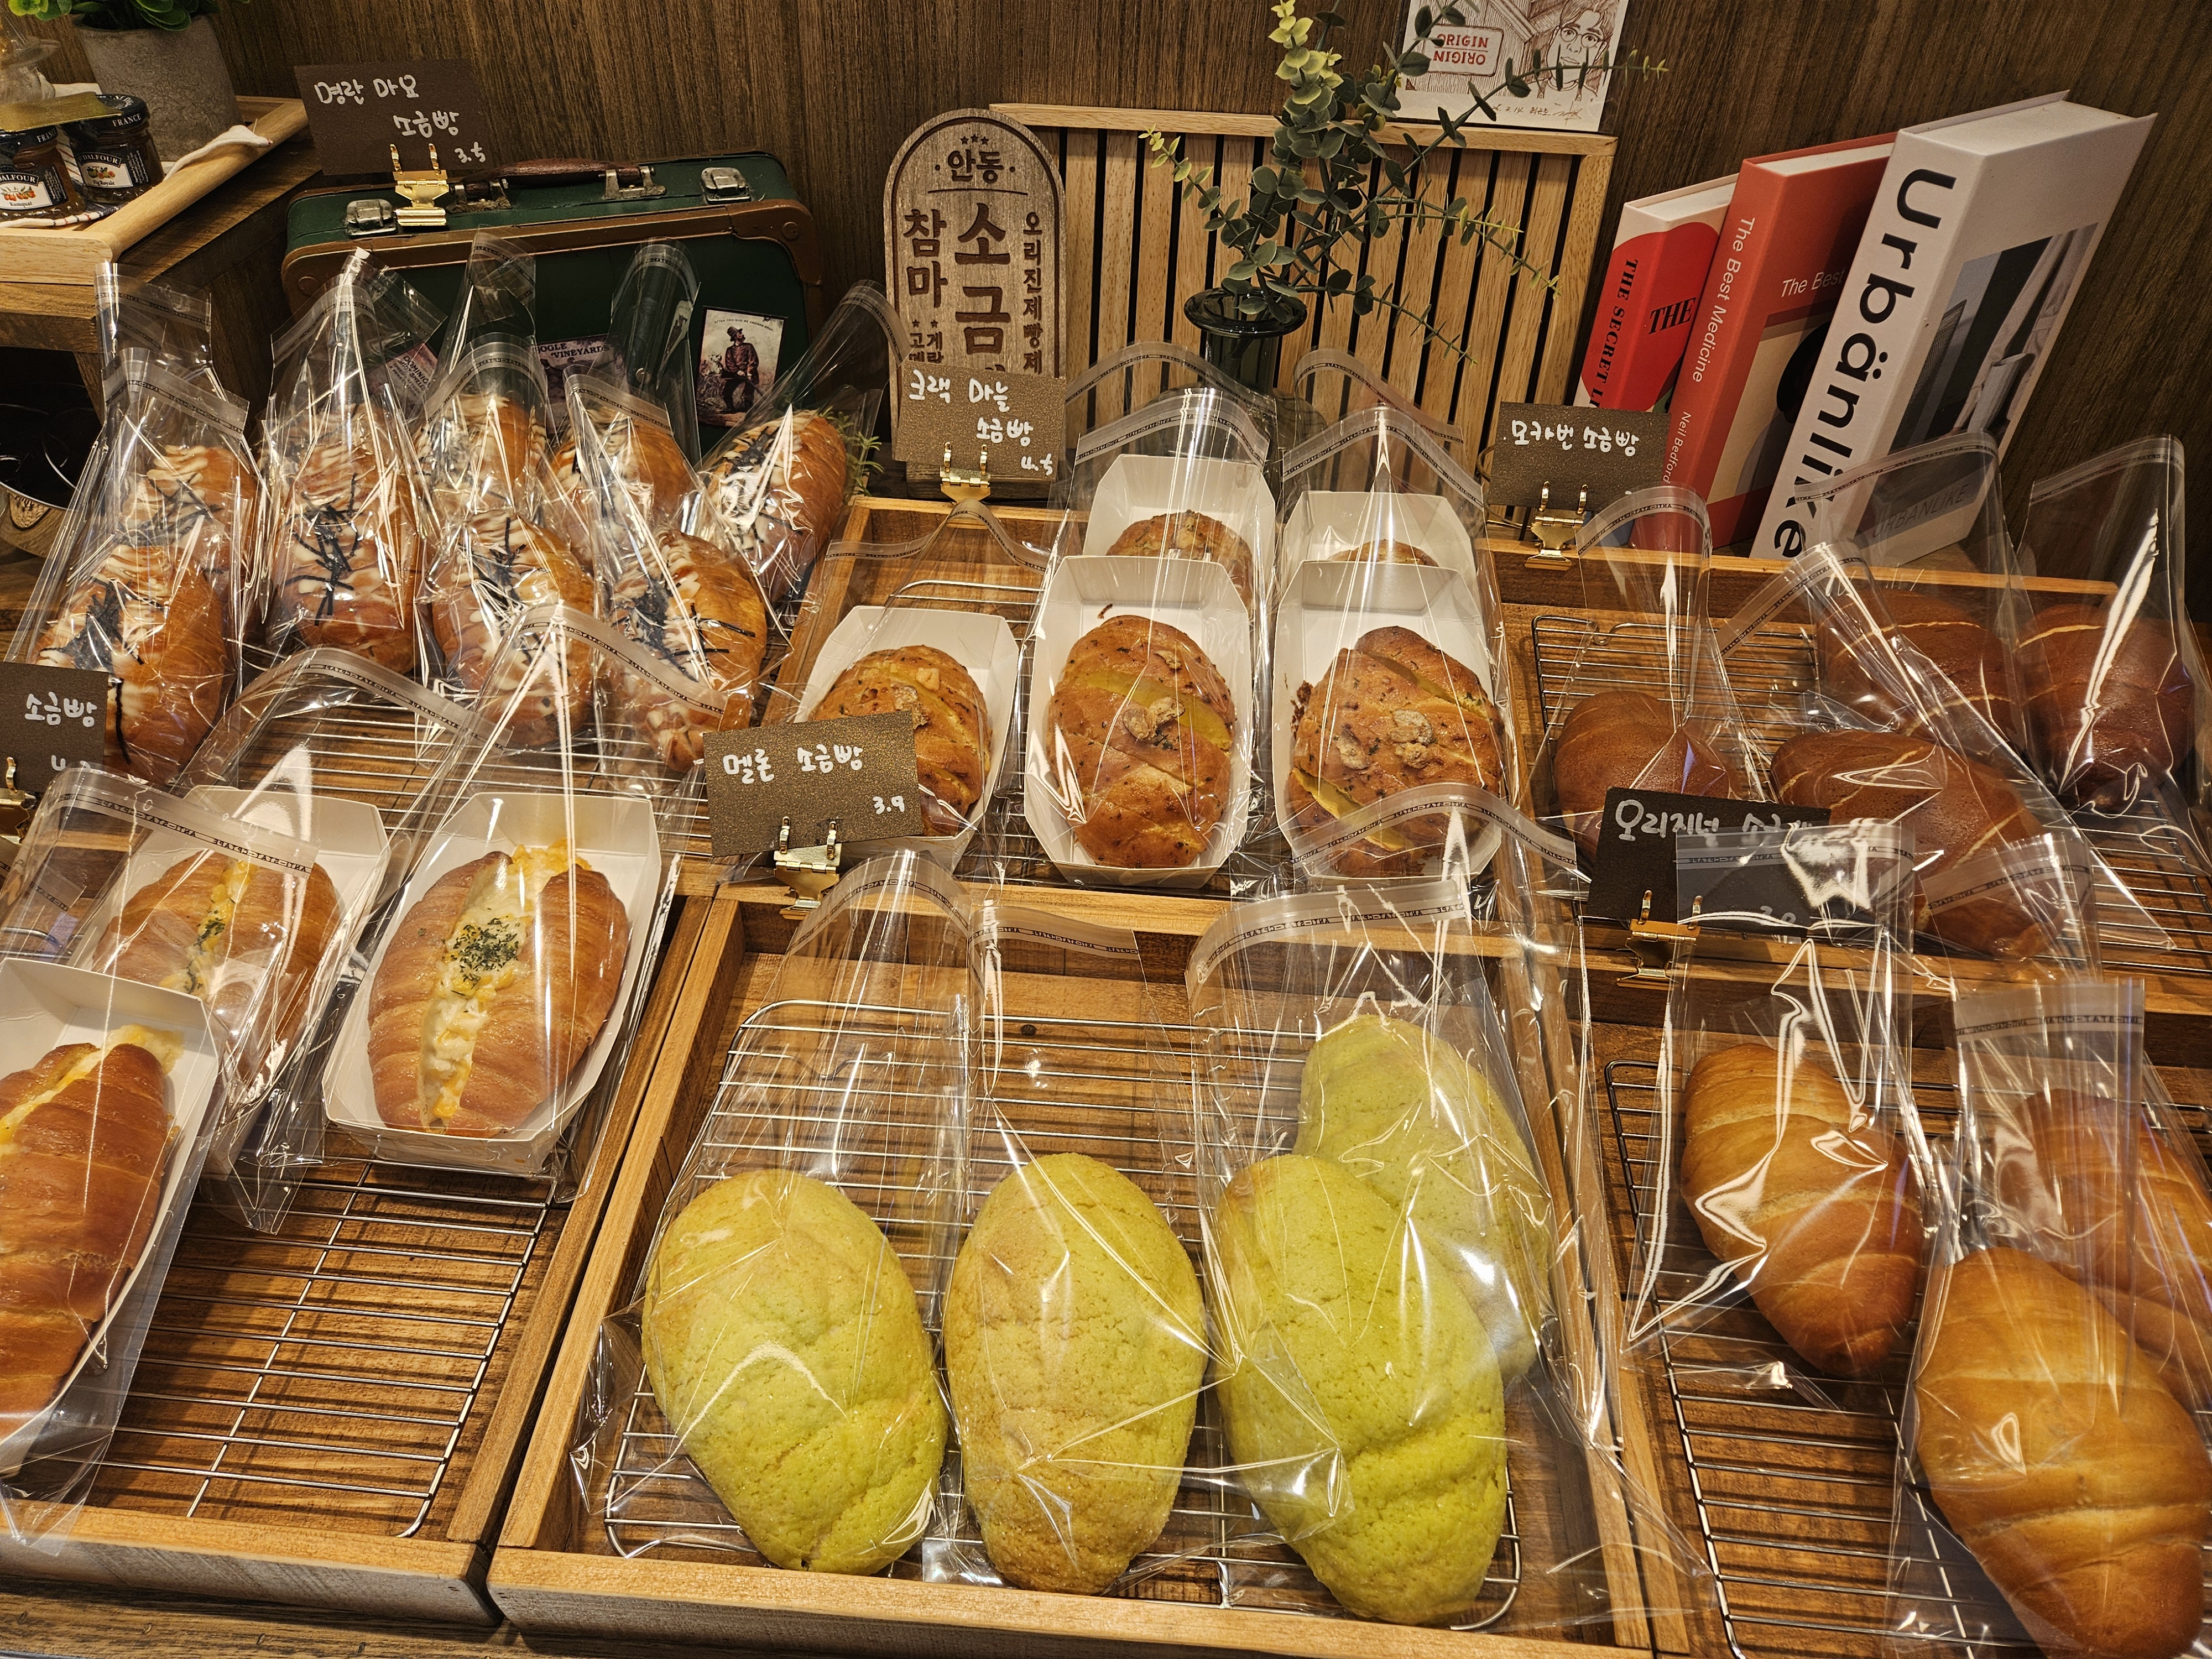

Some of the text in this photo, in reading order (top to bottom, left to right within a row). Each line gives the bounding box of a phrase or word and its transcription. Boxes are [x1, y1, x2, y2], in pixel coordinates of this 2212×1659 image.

[1437, 33, 1489, 48] ORIGIN
[314, 74, 419, 105] 명란 마요
[112, 113, 142, 127] FRANCE
[393, 111, 460, 138] 소금빵
[455, 142, 486, 163] 3.5
[947, 149, 1004, 184] 안동
[903, 208, 949, 308] 참마
[954, 202, 1011, 372] 소금
[1618, 259, 1638, 300] THE
[1781, 267, 1845, 298] The Best
[1648, 297, 1696, 335] THE
[1693, 217, 1755, 382] The Best Medicine
[536, 343, 567, 354] OGLE
[551, 345, 610, 358] VINEYARDS
[1597, 306, 1625, 383] SECRET
[1774, 169, 1957, 558] Urbänlike
[969, 378, 1010, 413] 마늘
[977, 418, 1034, 447] 소금빵
[1511, 420, 1639, 457] 모카번 소금빵
[1663, 411, 1691, 483] Neil Bedford
[1021, 453, 1053, 476] 4.5
[1873, 484, 1969, 538] URBANLIKE
[25, 692, 97, 727] 소금빵
[723, 744, 863, 784] 멜론 소금빵
[873, 795, 905, 815] 3.9
